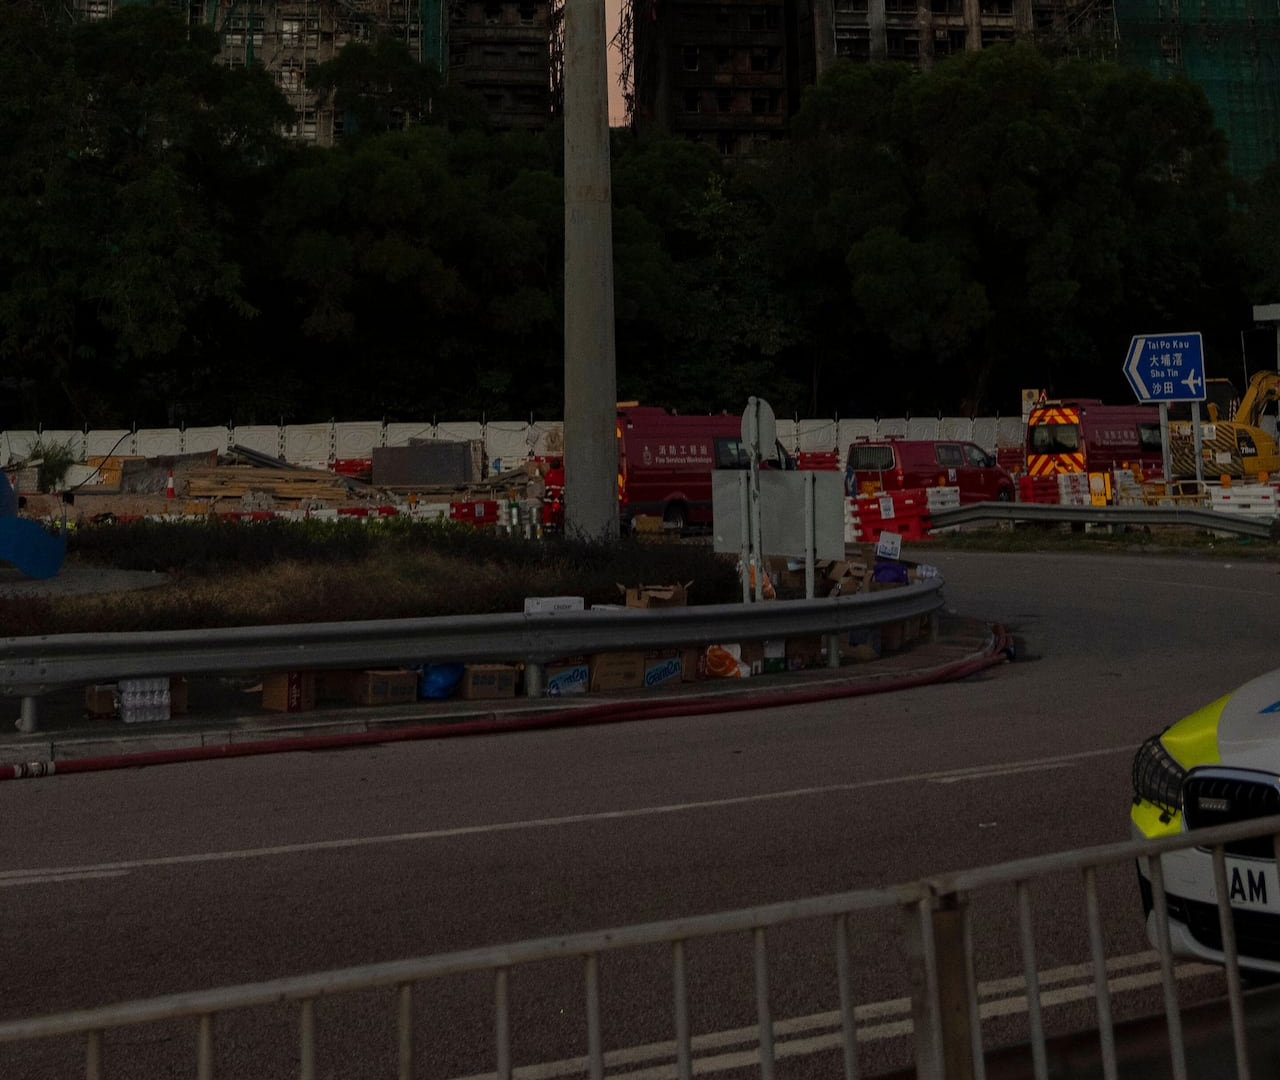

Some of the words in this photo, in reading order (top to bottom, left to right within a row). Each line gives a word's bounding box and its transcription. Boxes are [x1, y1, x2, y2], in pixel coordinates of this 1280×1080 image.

[1147, 340, 1158, 350] Tai
[1160, 340, 1170, 349] Po
[1173, 339, 1189, 349] Kau
[1150, 369, 1165, 378] Sha
[1167, 368, 1178, 377] Tin
[1152, 381, 1174, 395] 沙田
[1230, 867, 1267, 904] AM
